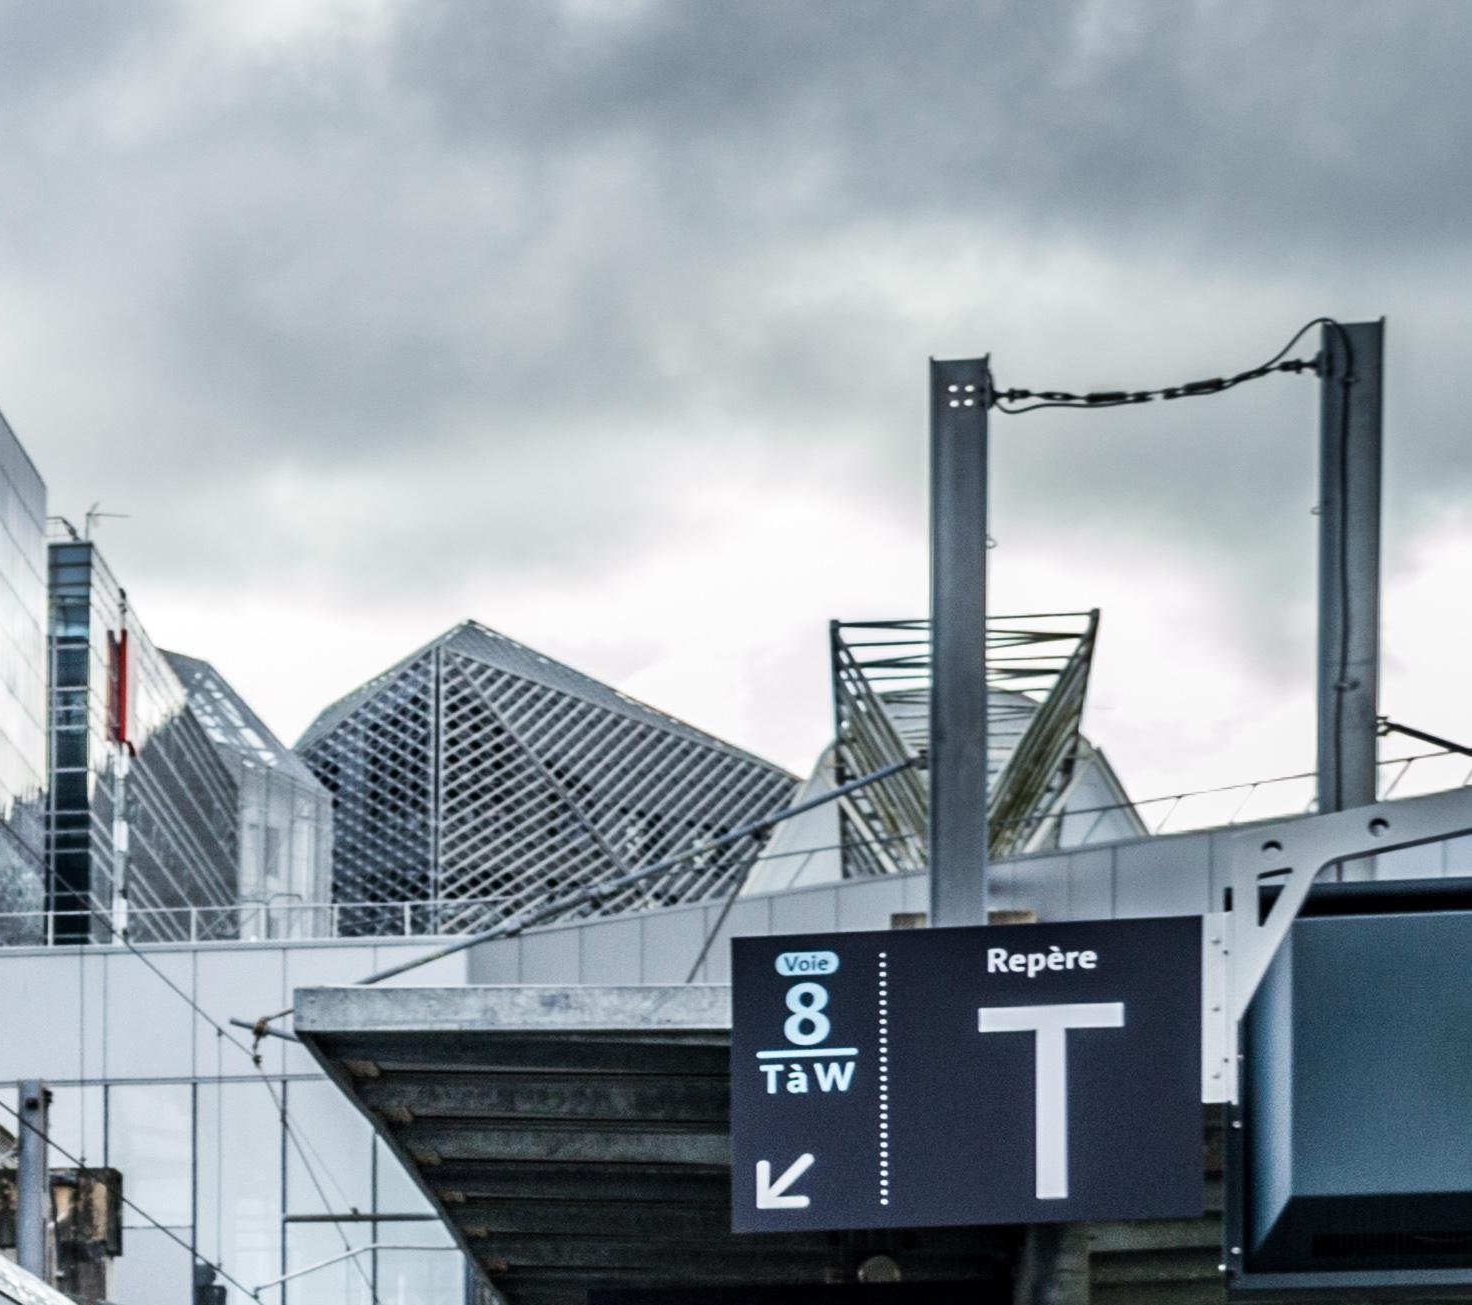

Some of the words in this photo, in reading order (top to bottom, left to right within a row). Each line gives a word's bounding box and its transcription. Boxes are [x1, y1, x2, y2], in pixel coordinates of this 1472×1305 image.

[784, 956, 829, 971] Voie
[987, 945, 1098, 978] Repère
[784, 982, 831, 1046] 8
[759, 1063, 785, 1094] T
[786, 1063, 808, 1093] à
[813, 1061, 856, 1092] W
[978, 1002, 1124, 1199] T
